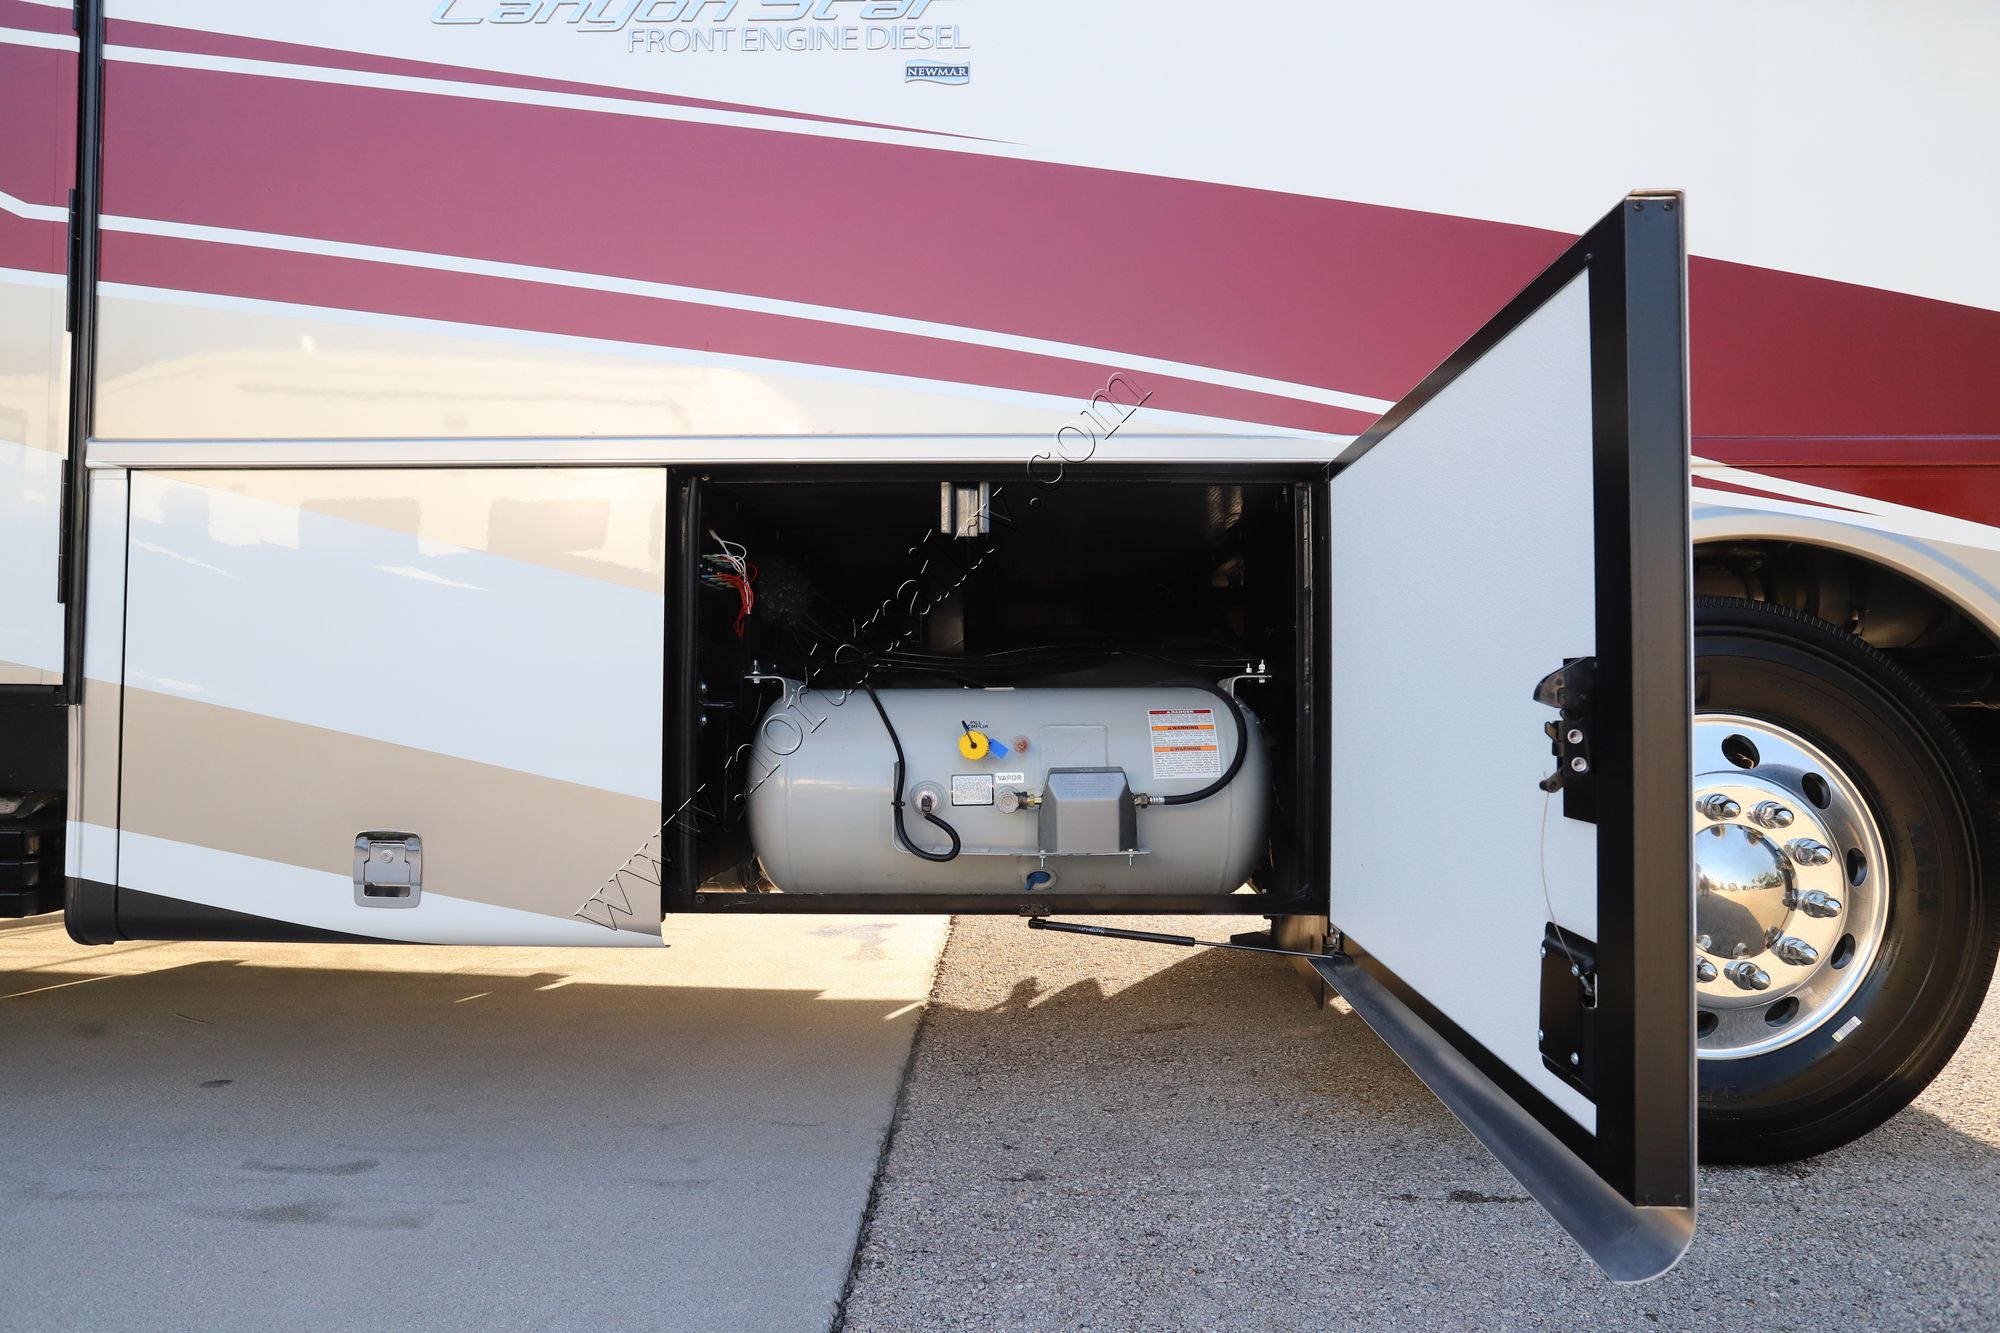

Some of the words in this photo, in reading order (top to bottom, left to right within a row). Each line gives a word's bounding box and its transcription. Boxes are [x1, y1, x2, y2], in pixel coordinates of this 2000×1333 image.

[430, 0, 737, 32] Canyon
[628, 27, 736, 53] FRONT
[741, 26, 859, 52] ENGINE
[866, 25, 971, 51] DIESEL
[906, 67, 968, 76] NEWMAR
[997, 774, 1023, 782] VAPOR
